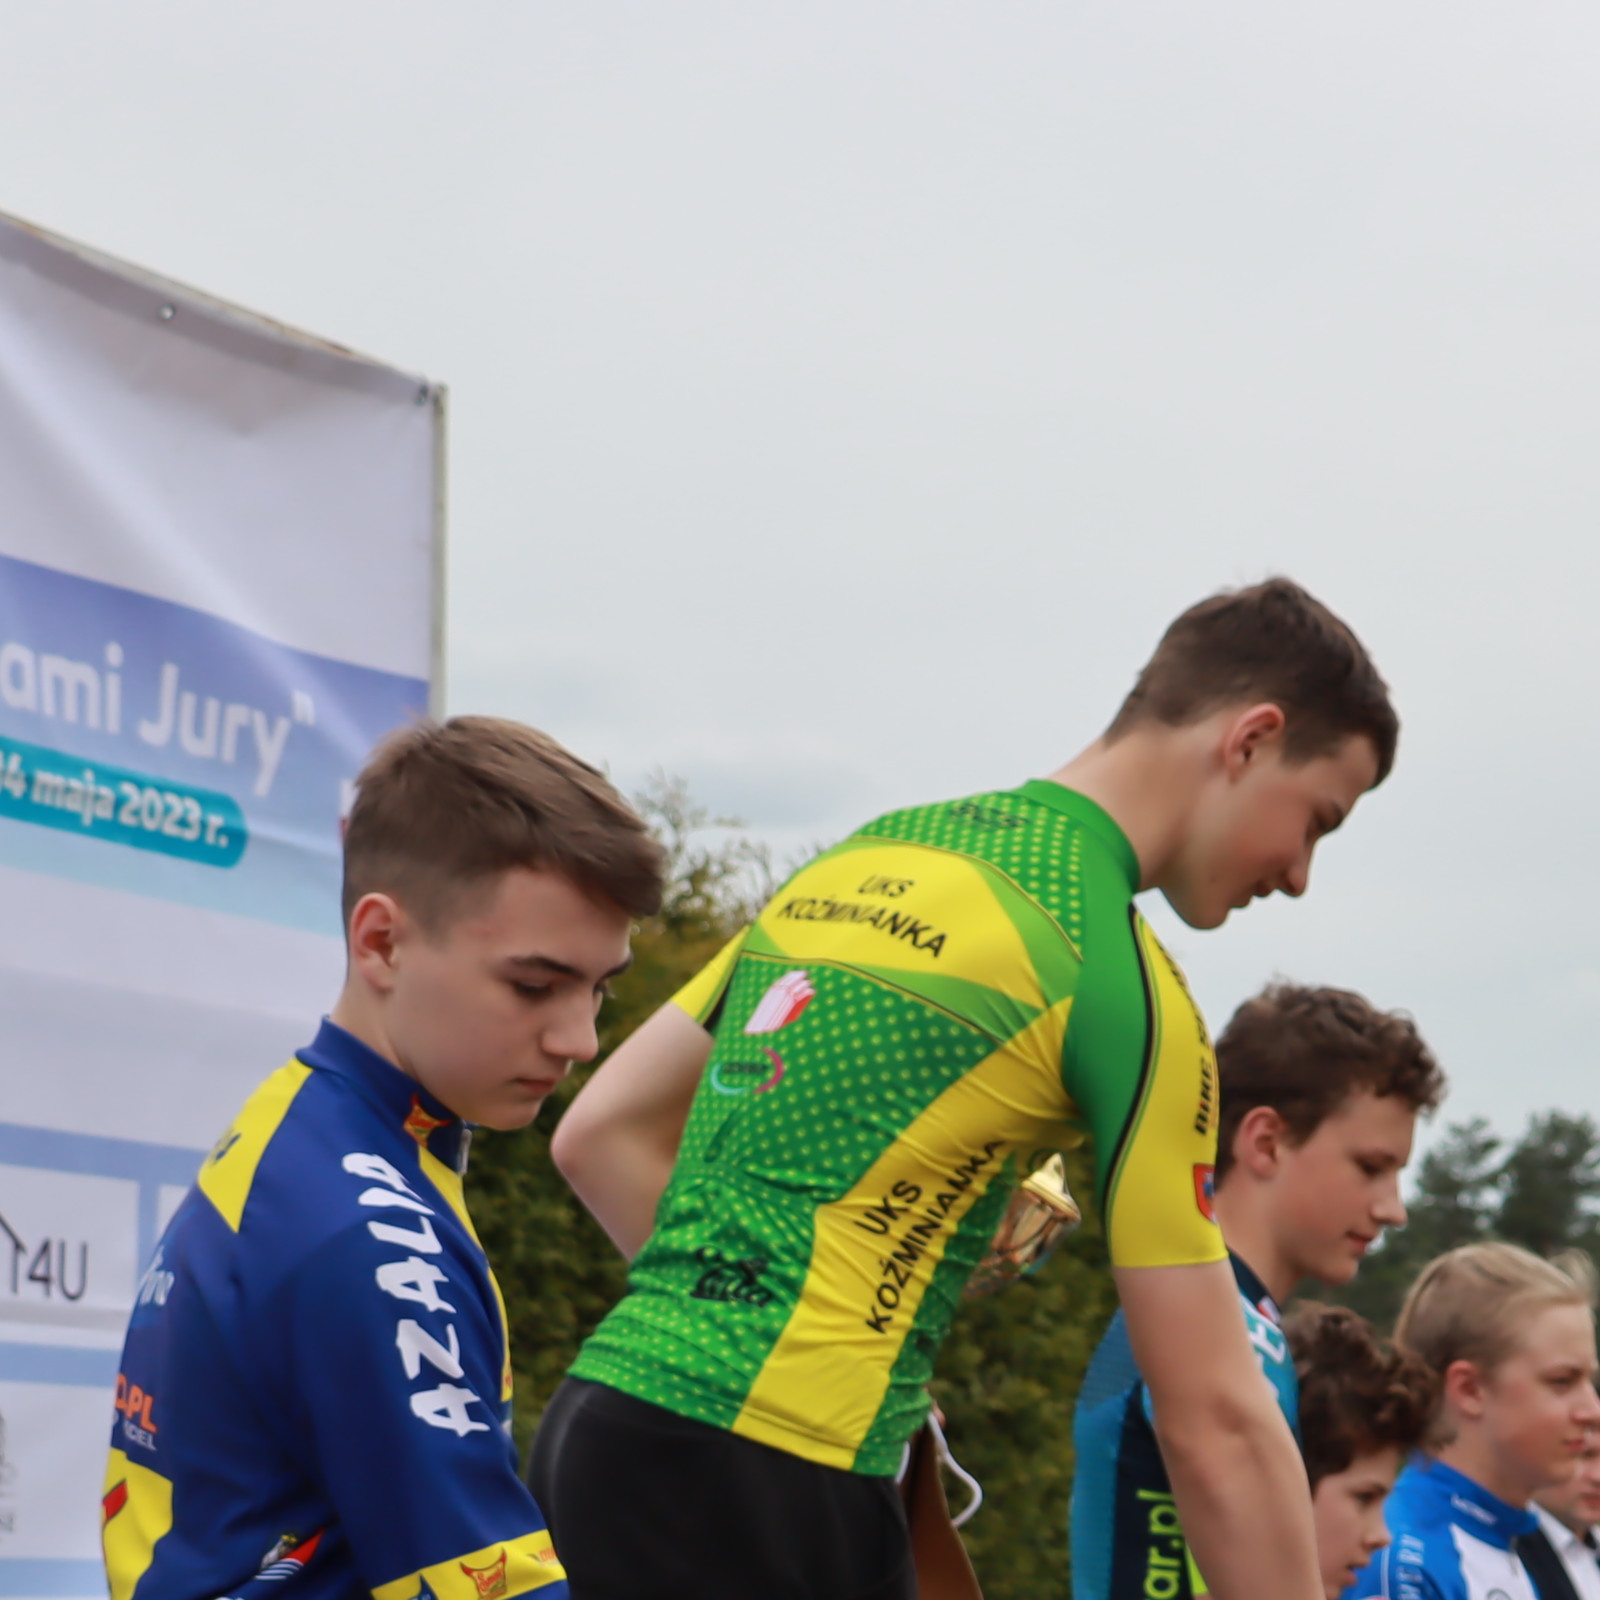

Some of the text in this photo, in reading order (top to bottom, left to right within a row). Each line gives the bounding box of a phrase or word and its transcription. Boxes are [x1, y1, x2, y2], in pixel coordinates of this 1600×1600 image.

[139, 662, 316, 797] Jury"
[32, 766, 115, 828] maja
[117, 783, 203, 841] 2023
[203, 811, 229, 848] r.
[858, 874, 915, 898] UKS
[853, 1180, 923, 1235] UKS
[342, 1151, 490, 1438] AZALIA
